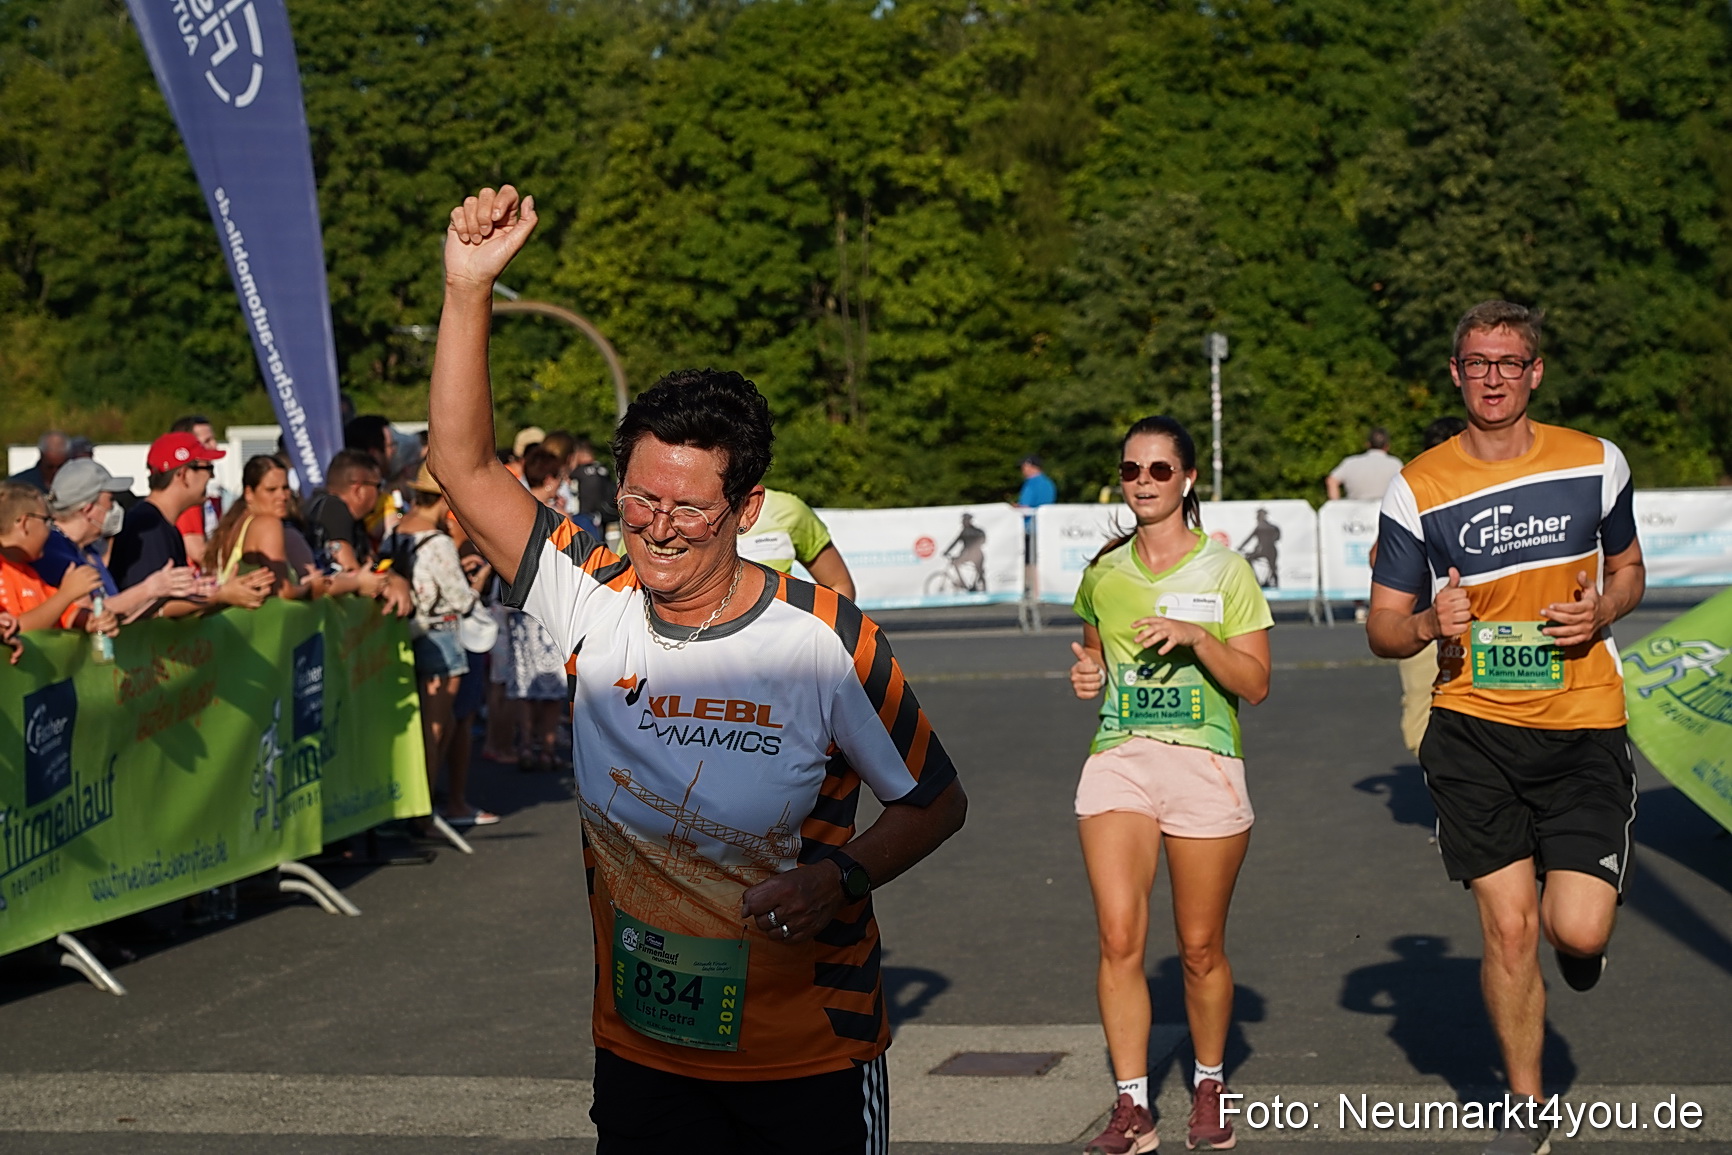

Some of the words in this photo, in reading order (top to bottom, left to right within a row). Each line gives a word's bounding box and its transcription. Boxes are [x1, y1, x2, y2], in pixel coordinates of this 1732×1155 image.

[1480, 515, 1572, 548] Fischer
[1491, 533, 1566, 556] AUTOMOBILE
[1477, 652, 1485, 675] RUN
[1487, 645, 1549, 668] 1860
[1489, 669, 1516, 677] Kamm
[1517, 669, 1549, 677] Manuel
[1122, 693, 1130, 718] RUN
[1136, 687, 1181, 709] 923
[1191, 688, 1201, 720] 2022
[649, 695, 783, 729] KLEBL
[1160, 709, 1191, 719] Nadine
[638, 709, 782, 755] DYNAMICS
[4, 753, 118, 874] firmenlauf
[638, 944, 680, 961] Firmenlauf
[652, 956, 678, 966] neumarkt
[616, 960, 625, 999] RUN
[634, 961, 705, 1011] 834
[636, 1000, 657, 1017] List
[659, 1008, 696, 1026] Petra
[718, 985, 737, 1035] 2022
